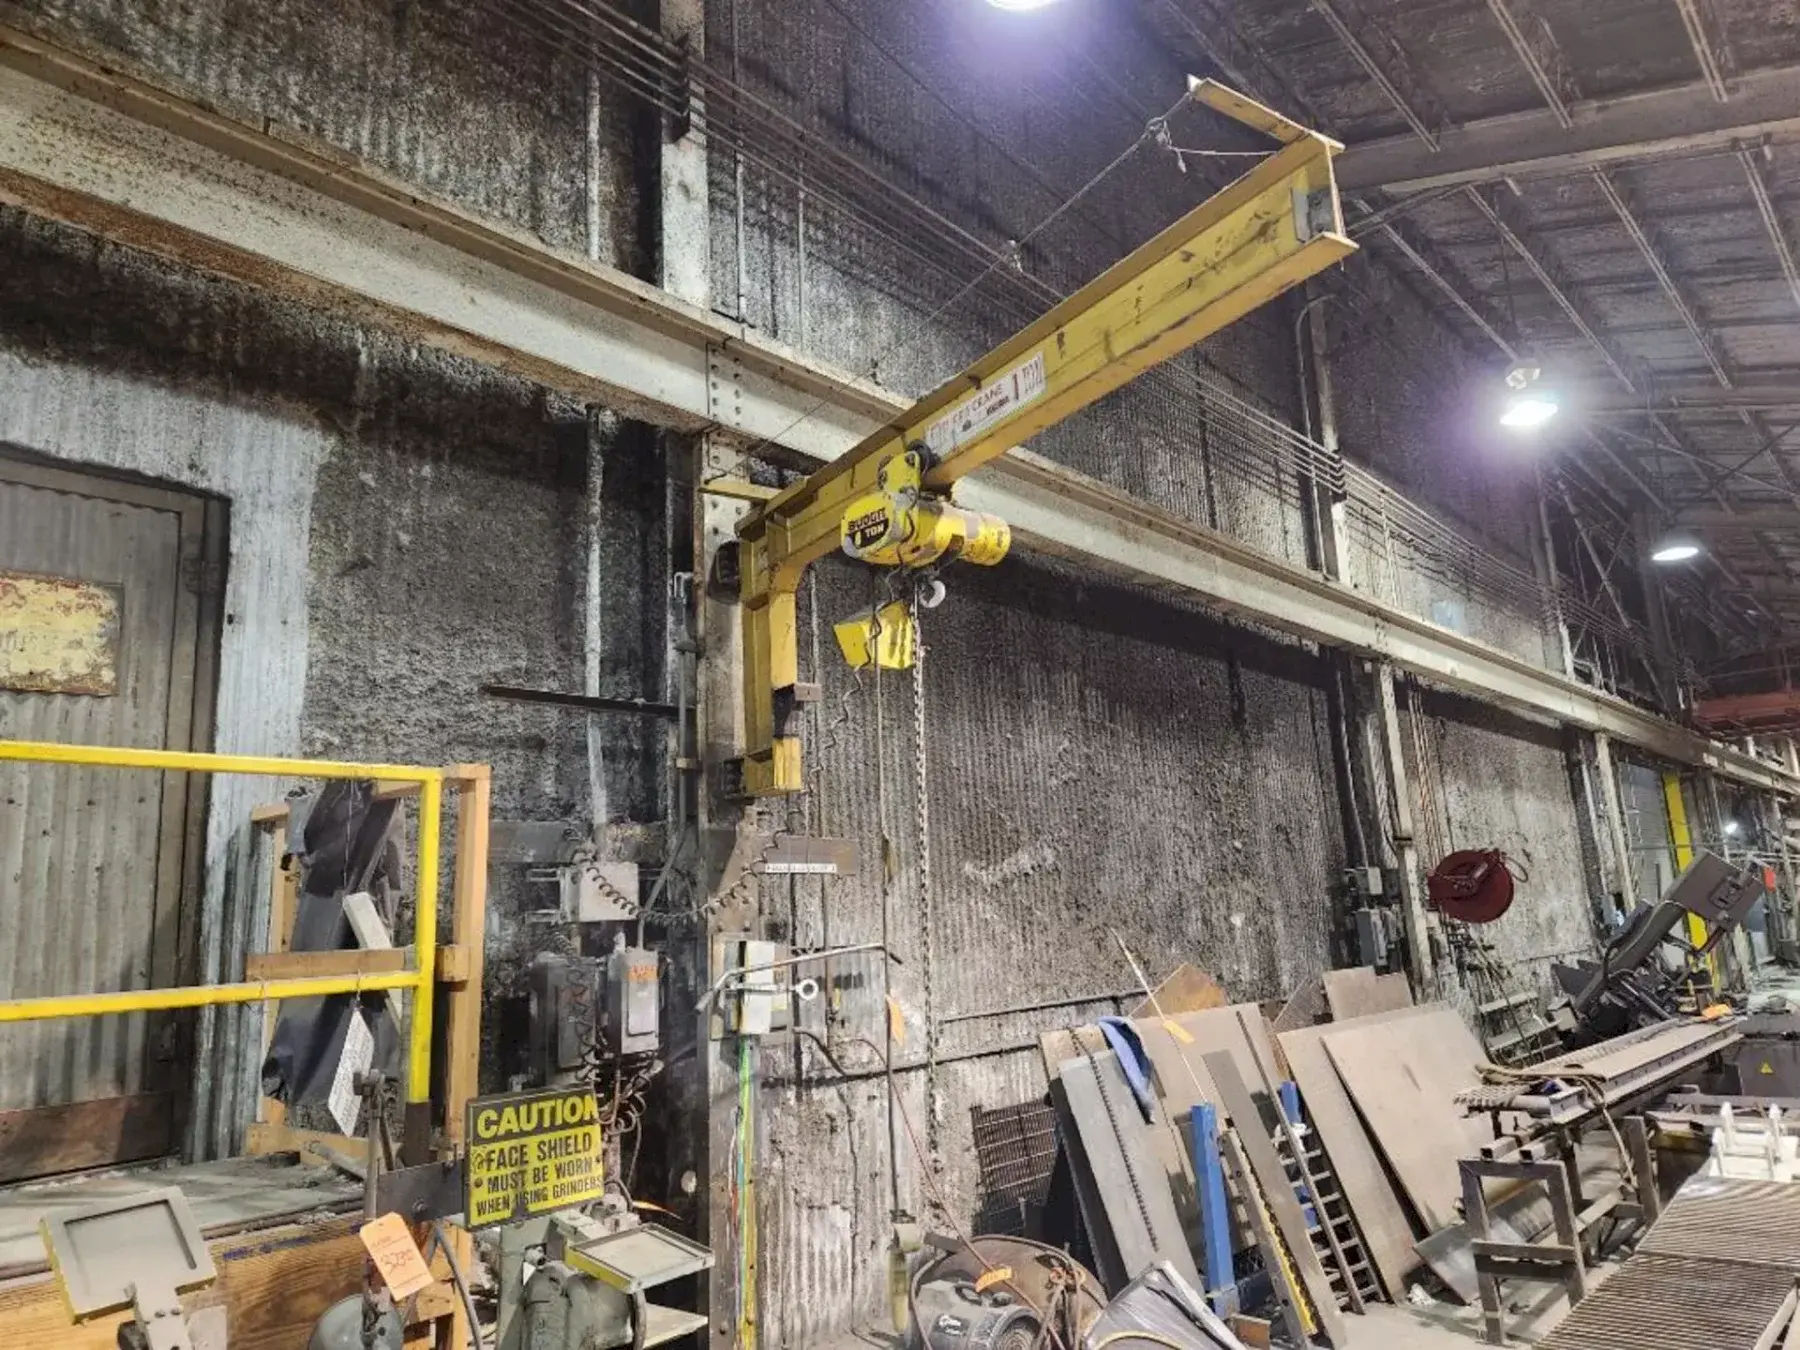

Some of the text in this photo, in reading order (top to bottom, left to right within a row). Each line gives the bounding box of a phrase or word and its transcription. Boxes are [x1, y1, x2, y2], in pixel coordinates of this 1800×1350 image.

[864, 523, 885, 538] TON
[477, 1094, 598, 1139] CAUTION
[486, 1132, 592, 1172] FACE SHIELD
[476, 1175, 601, 1216] WHEN USING GRINDERS
[487, 1158, 593, 1194] MUST BE WORN
